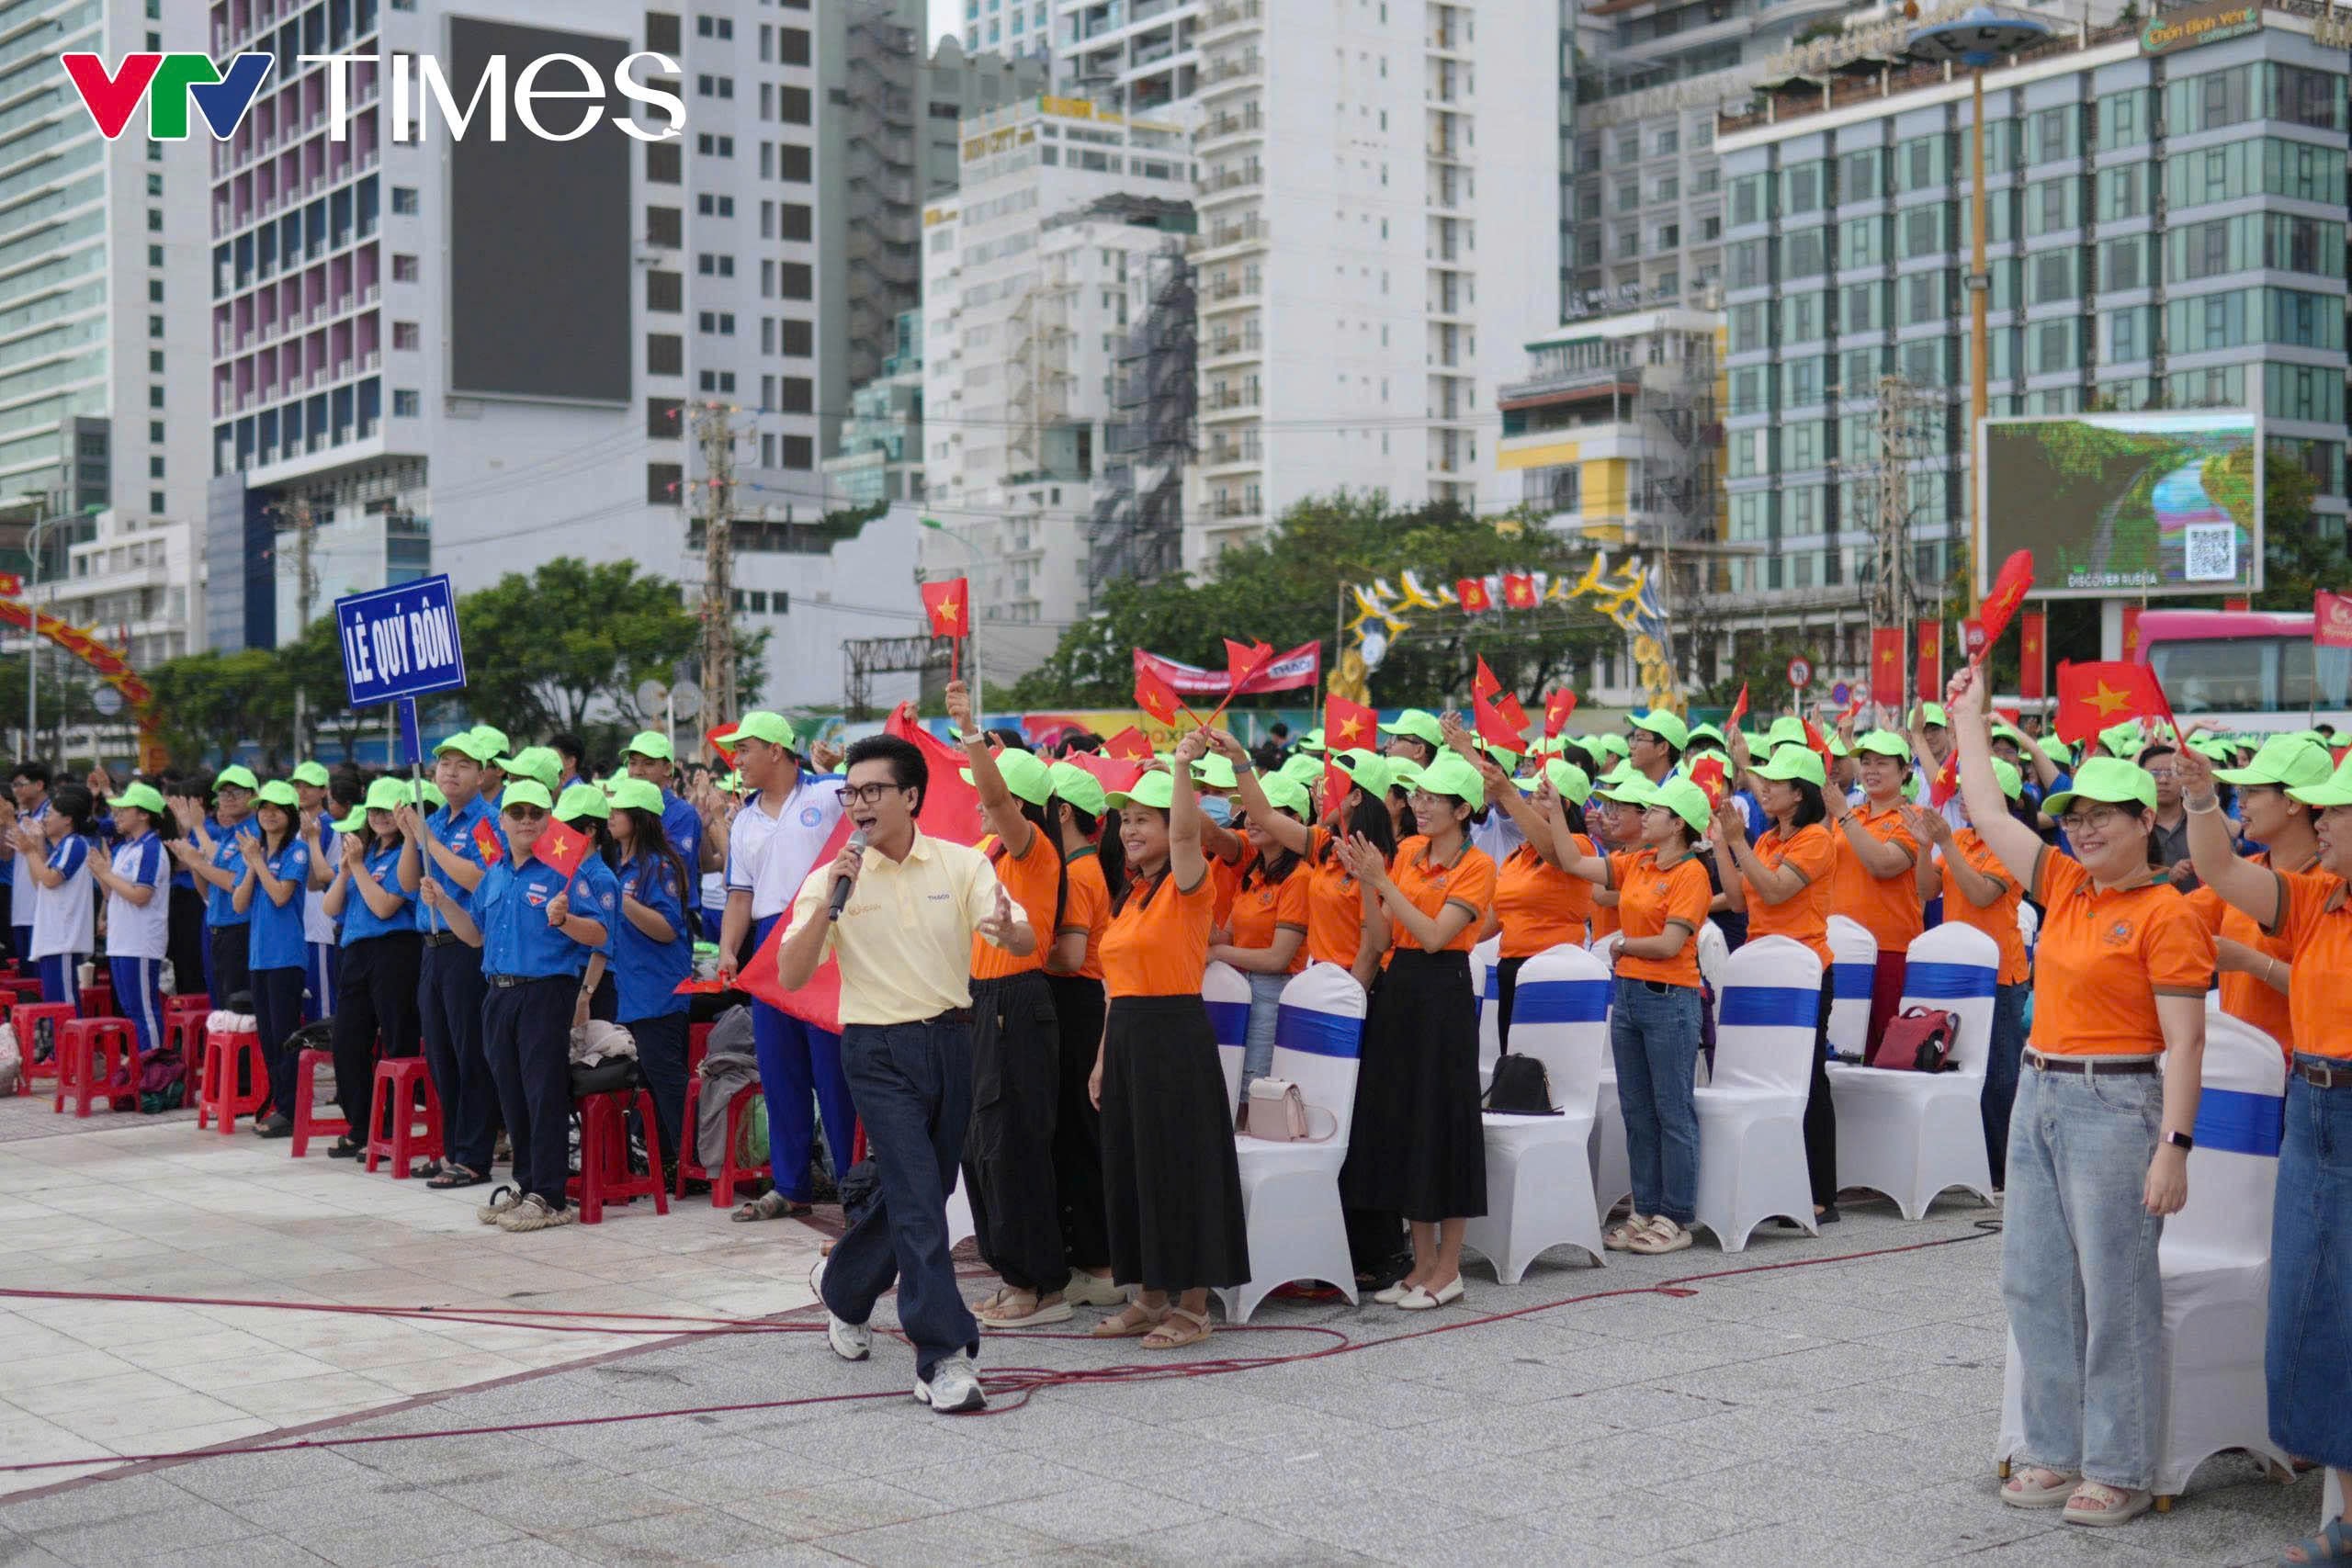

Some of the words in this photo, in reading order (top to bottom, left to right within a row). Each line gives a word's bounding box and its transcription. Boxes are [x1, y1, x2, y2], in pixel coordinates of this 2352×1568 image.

[2067, 571, 2120, 588] DISCOVER
[345, 611, 373, 684] LÊ
[371, 602, 411, 685] QUÝ
[409, 595, 454, 671] ĐÔN
